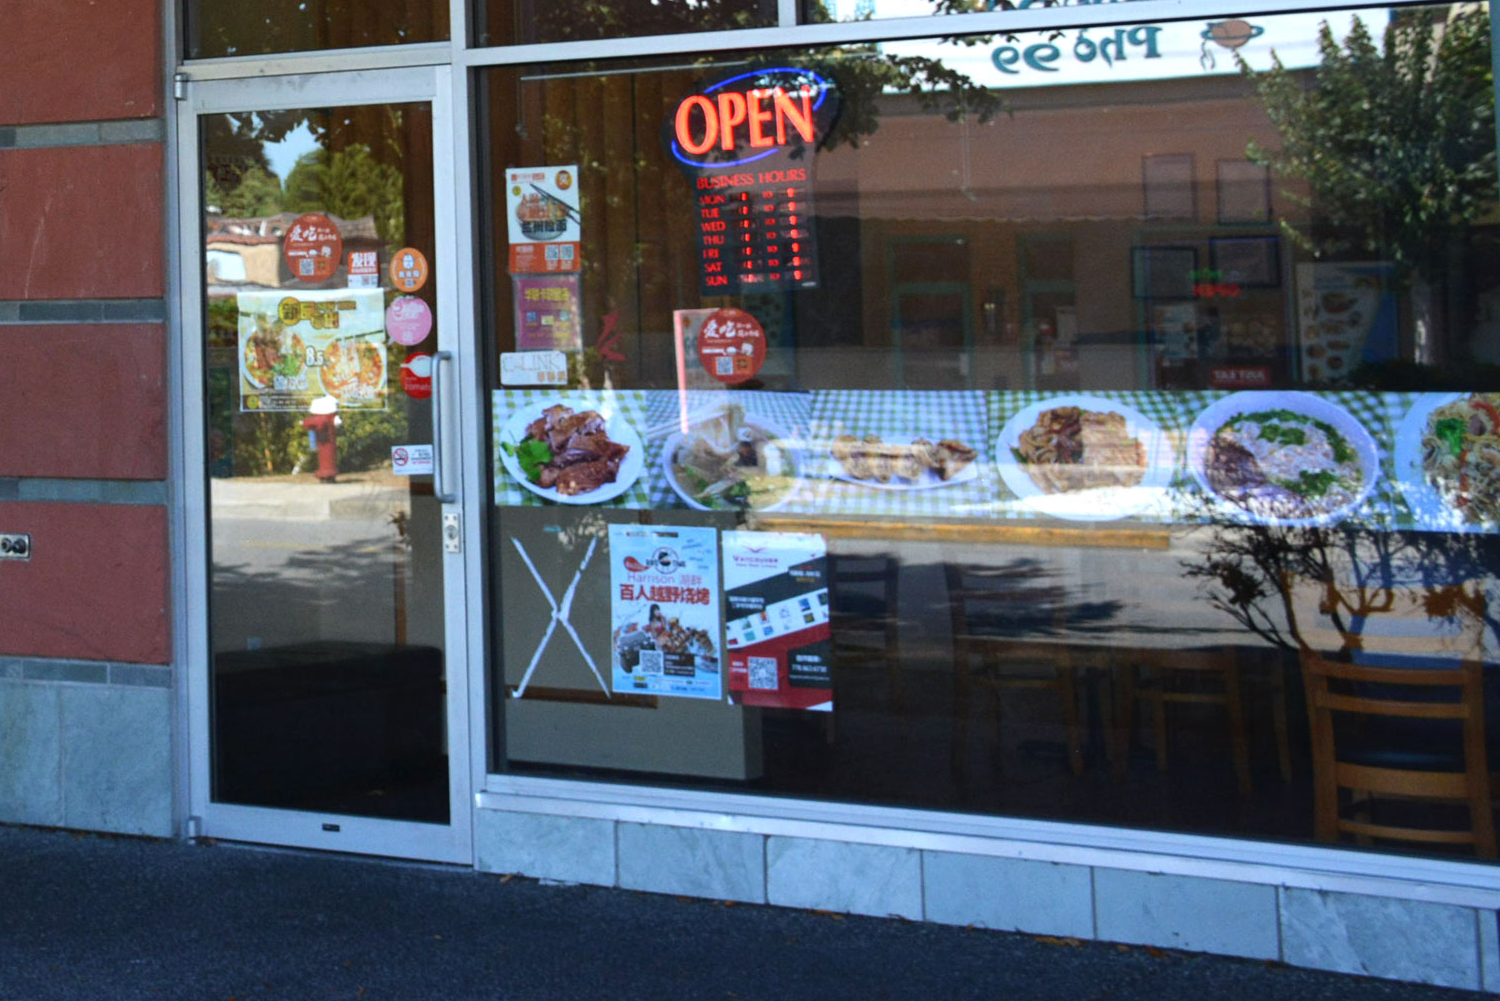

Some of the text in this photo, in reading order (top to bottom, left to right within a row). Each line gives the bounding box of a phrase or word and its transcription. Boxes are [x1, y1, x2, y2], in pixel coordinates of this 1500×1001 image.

[675, 85, 815, 155] OPEN
[697, 168, 807, 189] BUSINESS HOURS
[700, 194, 726, 205] MON
[701, 208, 719, 218] TUE
[701, 221, 727, 232] WED
[703, 235, 724, 245] THU
[703, 248, 719, 259] FRI
[704, 262, 722, 273] SAT
[706, 275, 728, 286] SUN
[627, 572, 676, 584] Harrison
